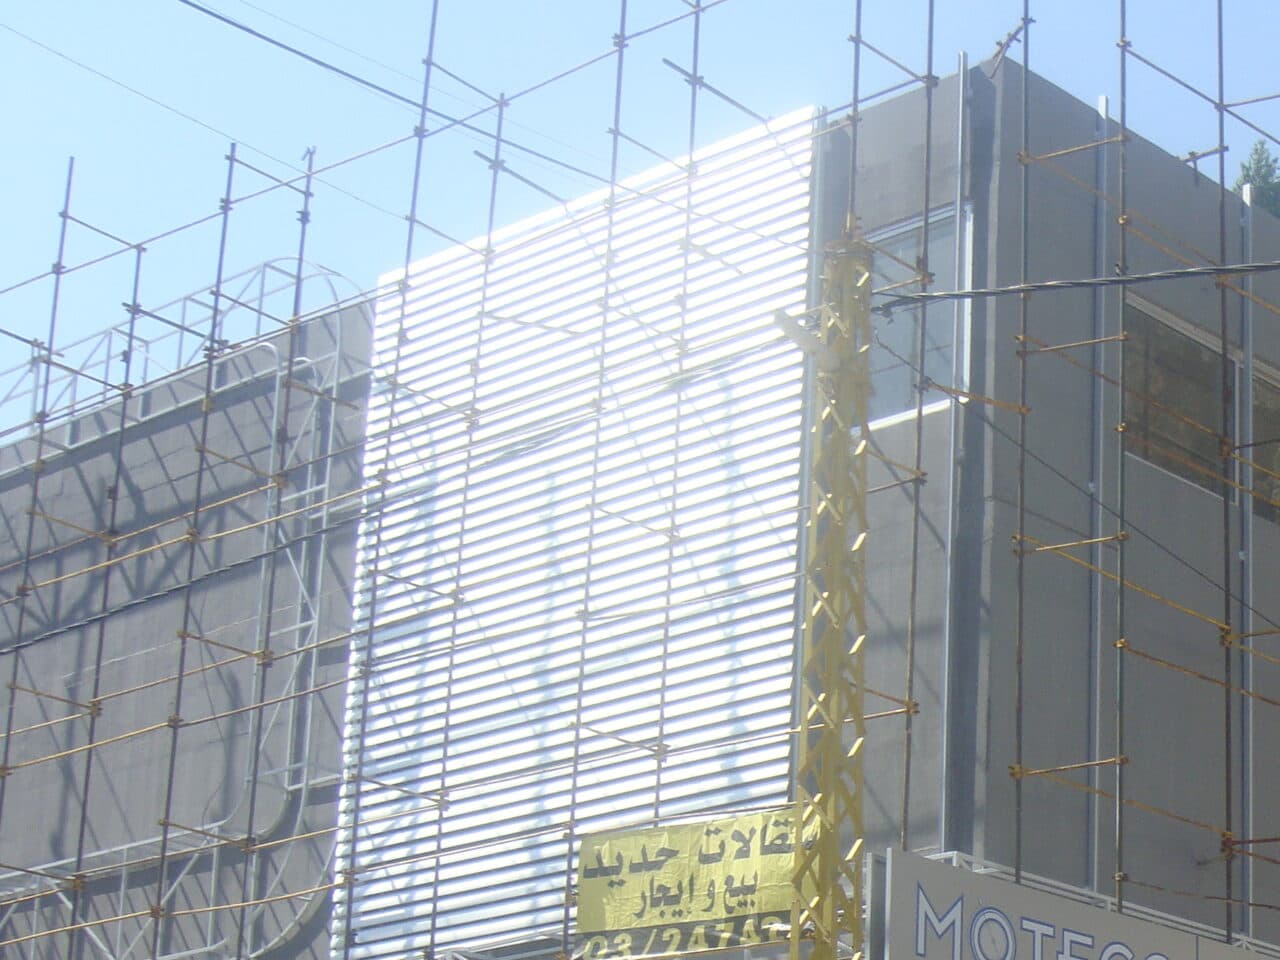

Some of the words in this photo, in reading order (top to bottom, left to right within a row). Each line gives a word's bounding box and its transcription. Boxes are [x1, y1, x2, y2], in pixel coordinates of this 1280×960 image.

[698, 819, 820, 865] قالات
[583, 843, 679, 889] حديد
[701, 878, 715, 913] و
[723, 870, 758, 915] بيع
